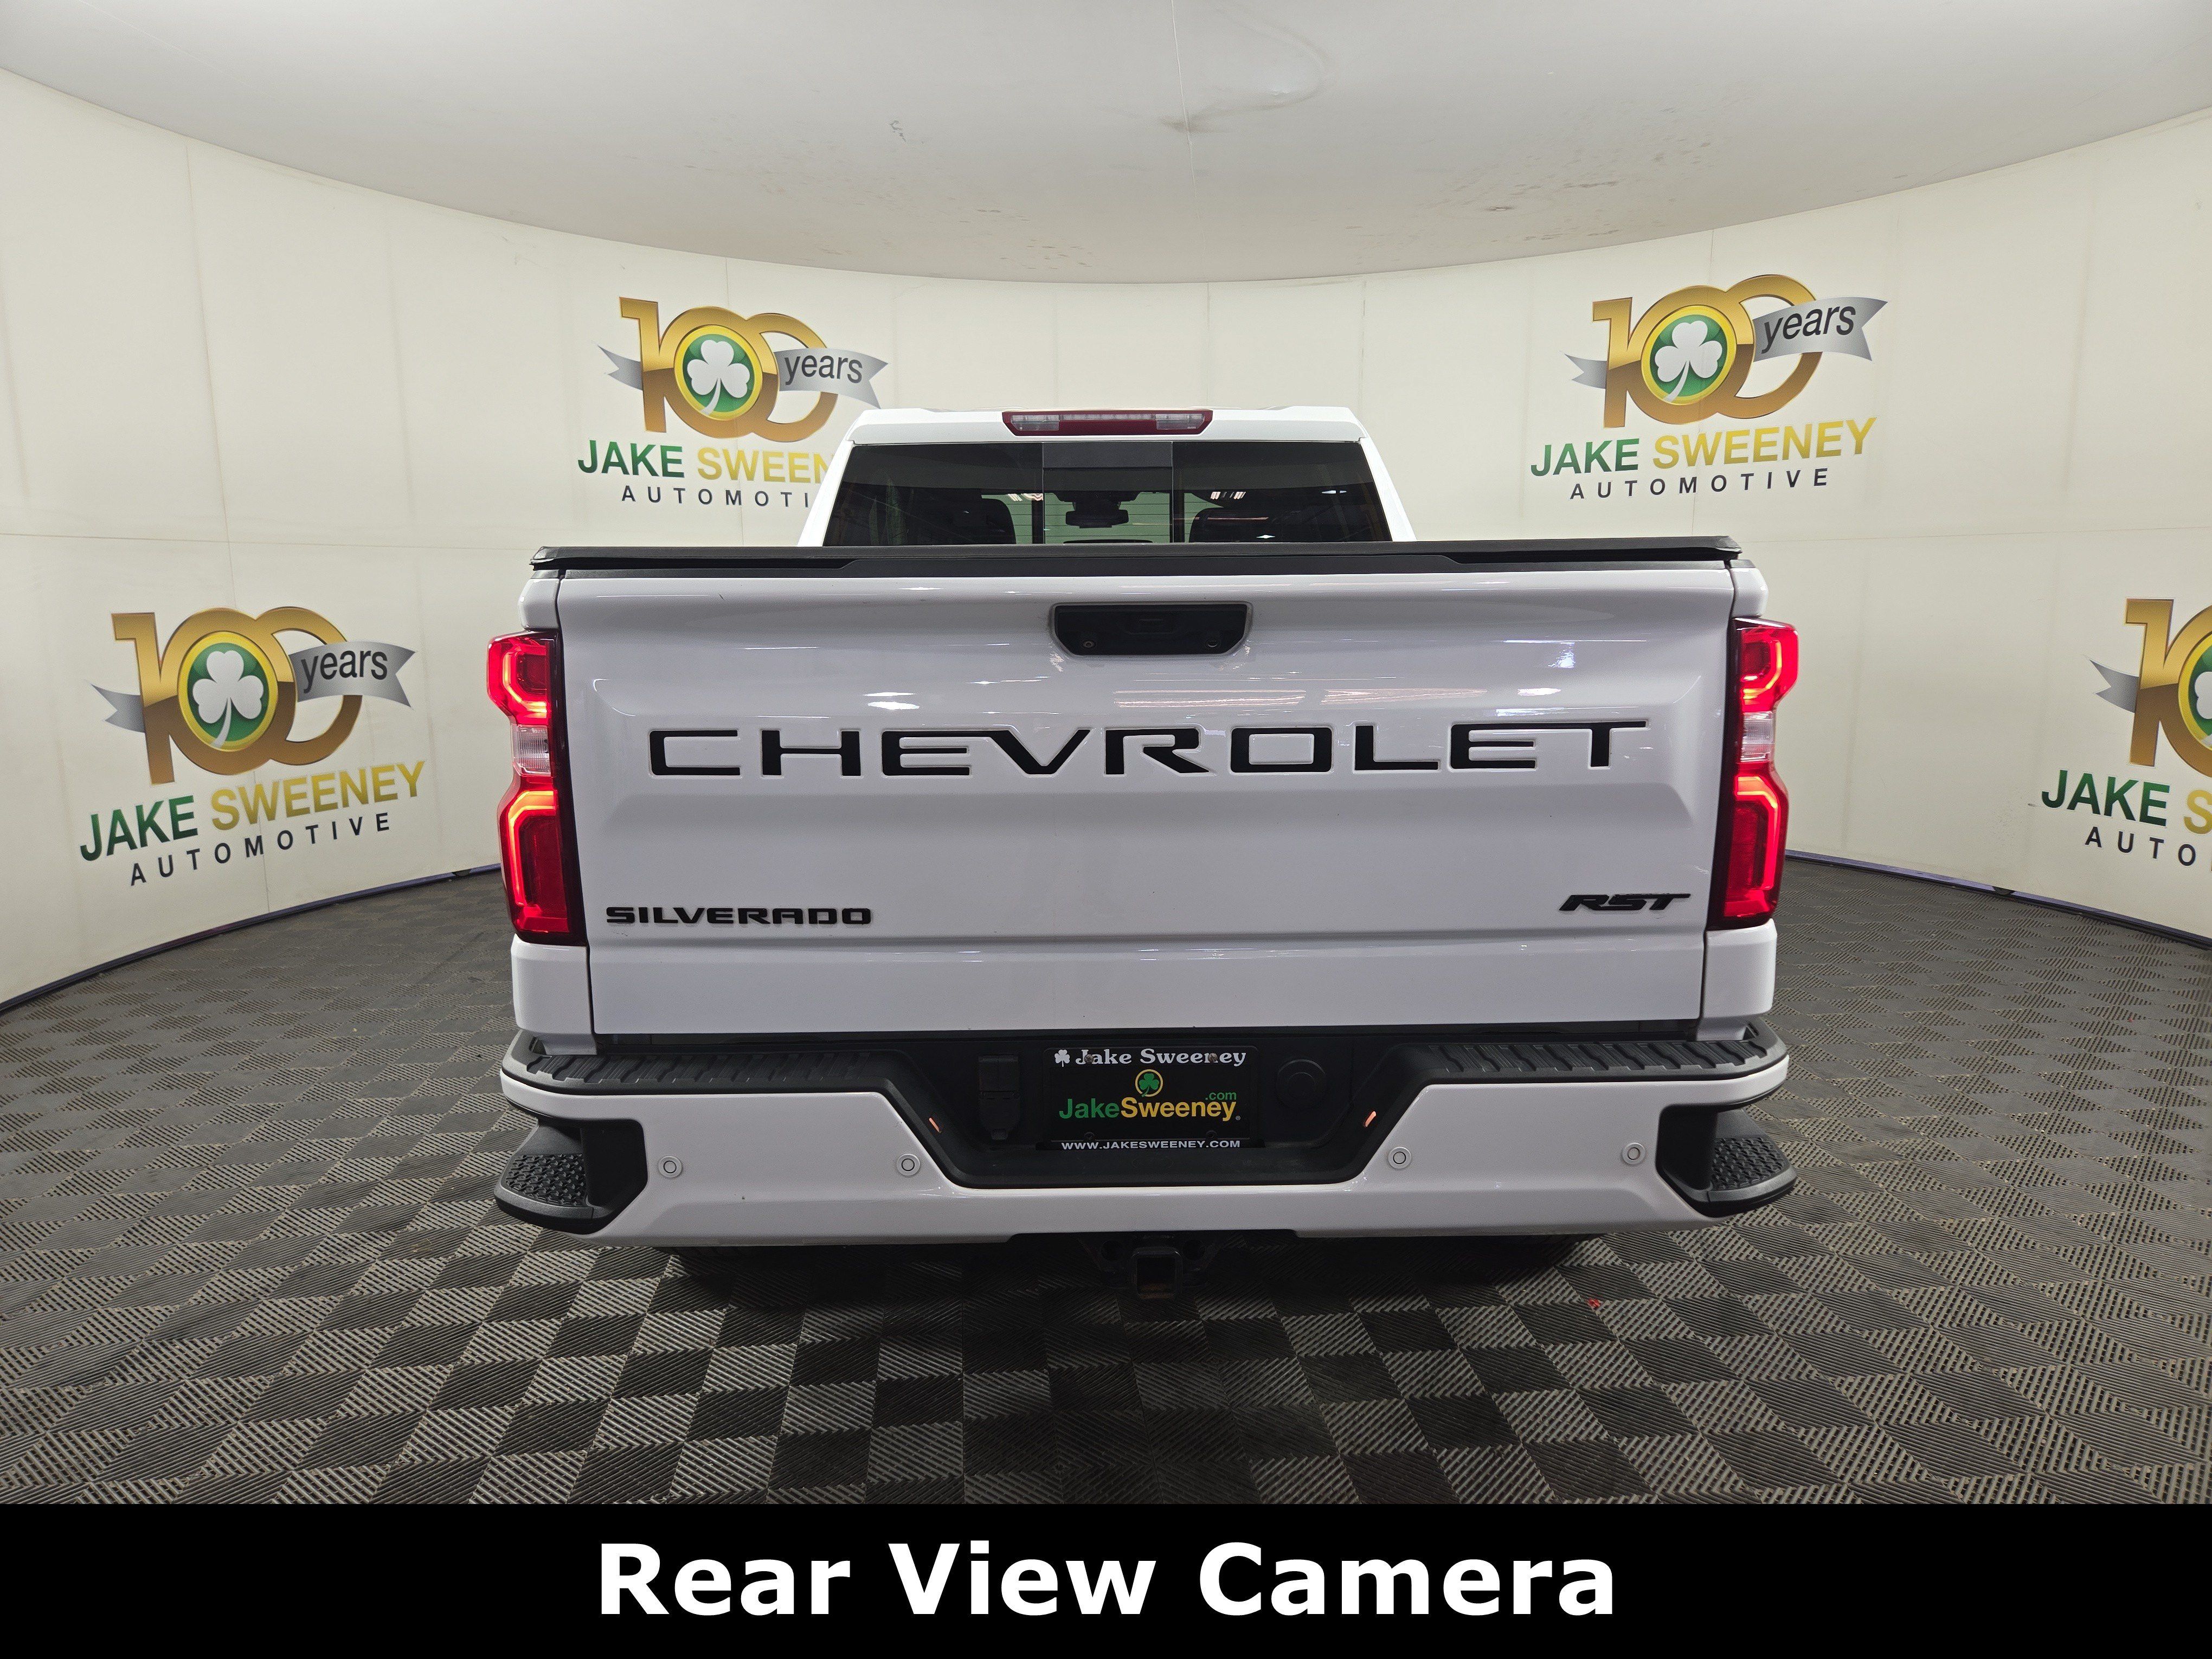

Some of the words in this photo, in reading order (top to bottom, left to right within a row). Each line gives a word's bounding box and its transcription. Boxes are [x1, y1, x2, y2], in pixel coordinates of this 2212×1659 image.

[1760, 306, 1856, 354] years
[784, 354, 863, 385] years
[577, 440, 685, 478] JAKE
[1531, 438, 1639, 477] JAKE
[1652, 417, 1877, 470] SWEENEY
[1570, 468, 1828, 500] AUTOMOTIVE
[301, 650, 388, 693] years
[649, 721, 1647, 777] CHEVROLET
[80, 795, 198, 862] JAKE
[210, 761, 426, 831] SWEENEY
[2042, 769, 2170, 827] JAKE
[130, 812, 390, 886] AUTOMOTIVE
[2085, 826, 2212, 871] AUTO
[606, 906, 872, 925] SILVERADO
[1558, 893, 1690, 911] RST
[1075, 1049, 1132, 1065] Jake
[1140, 1048, 1246, 1067] Sweeney
[1061, 1140, 1240, 1150] WWW.JAKESWEENEY.COM
